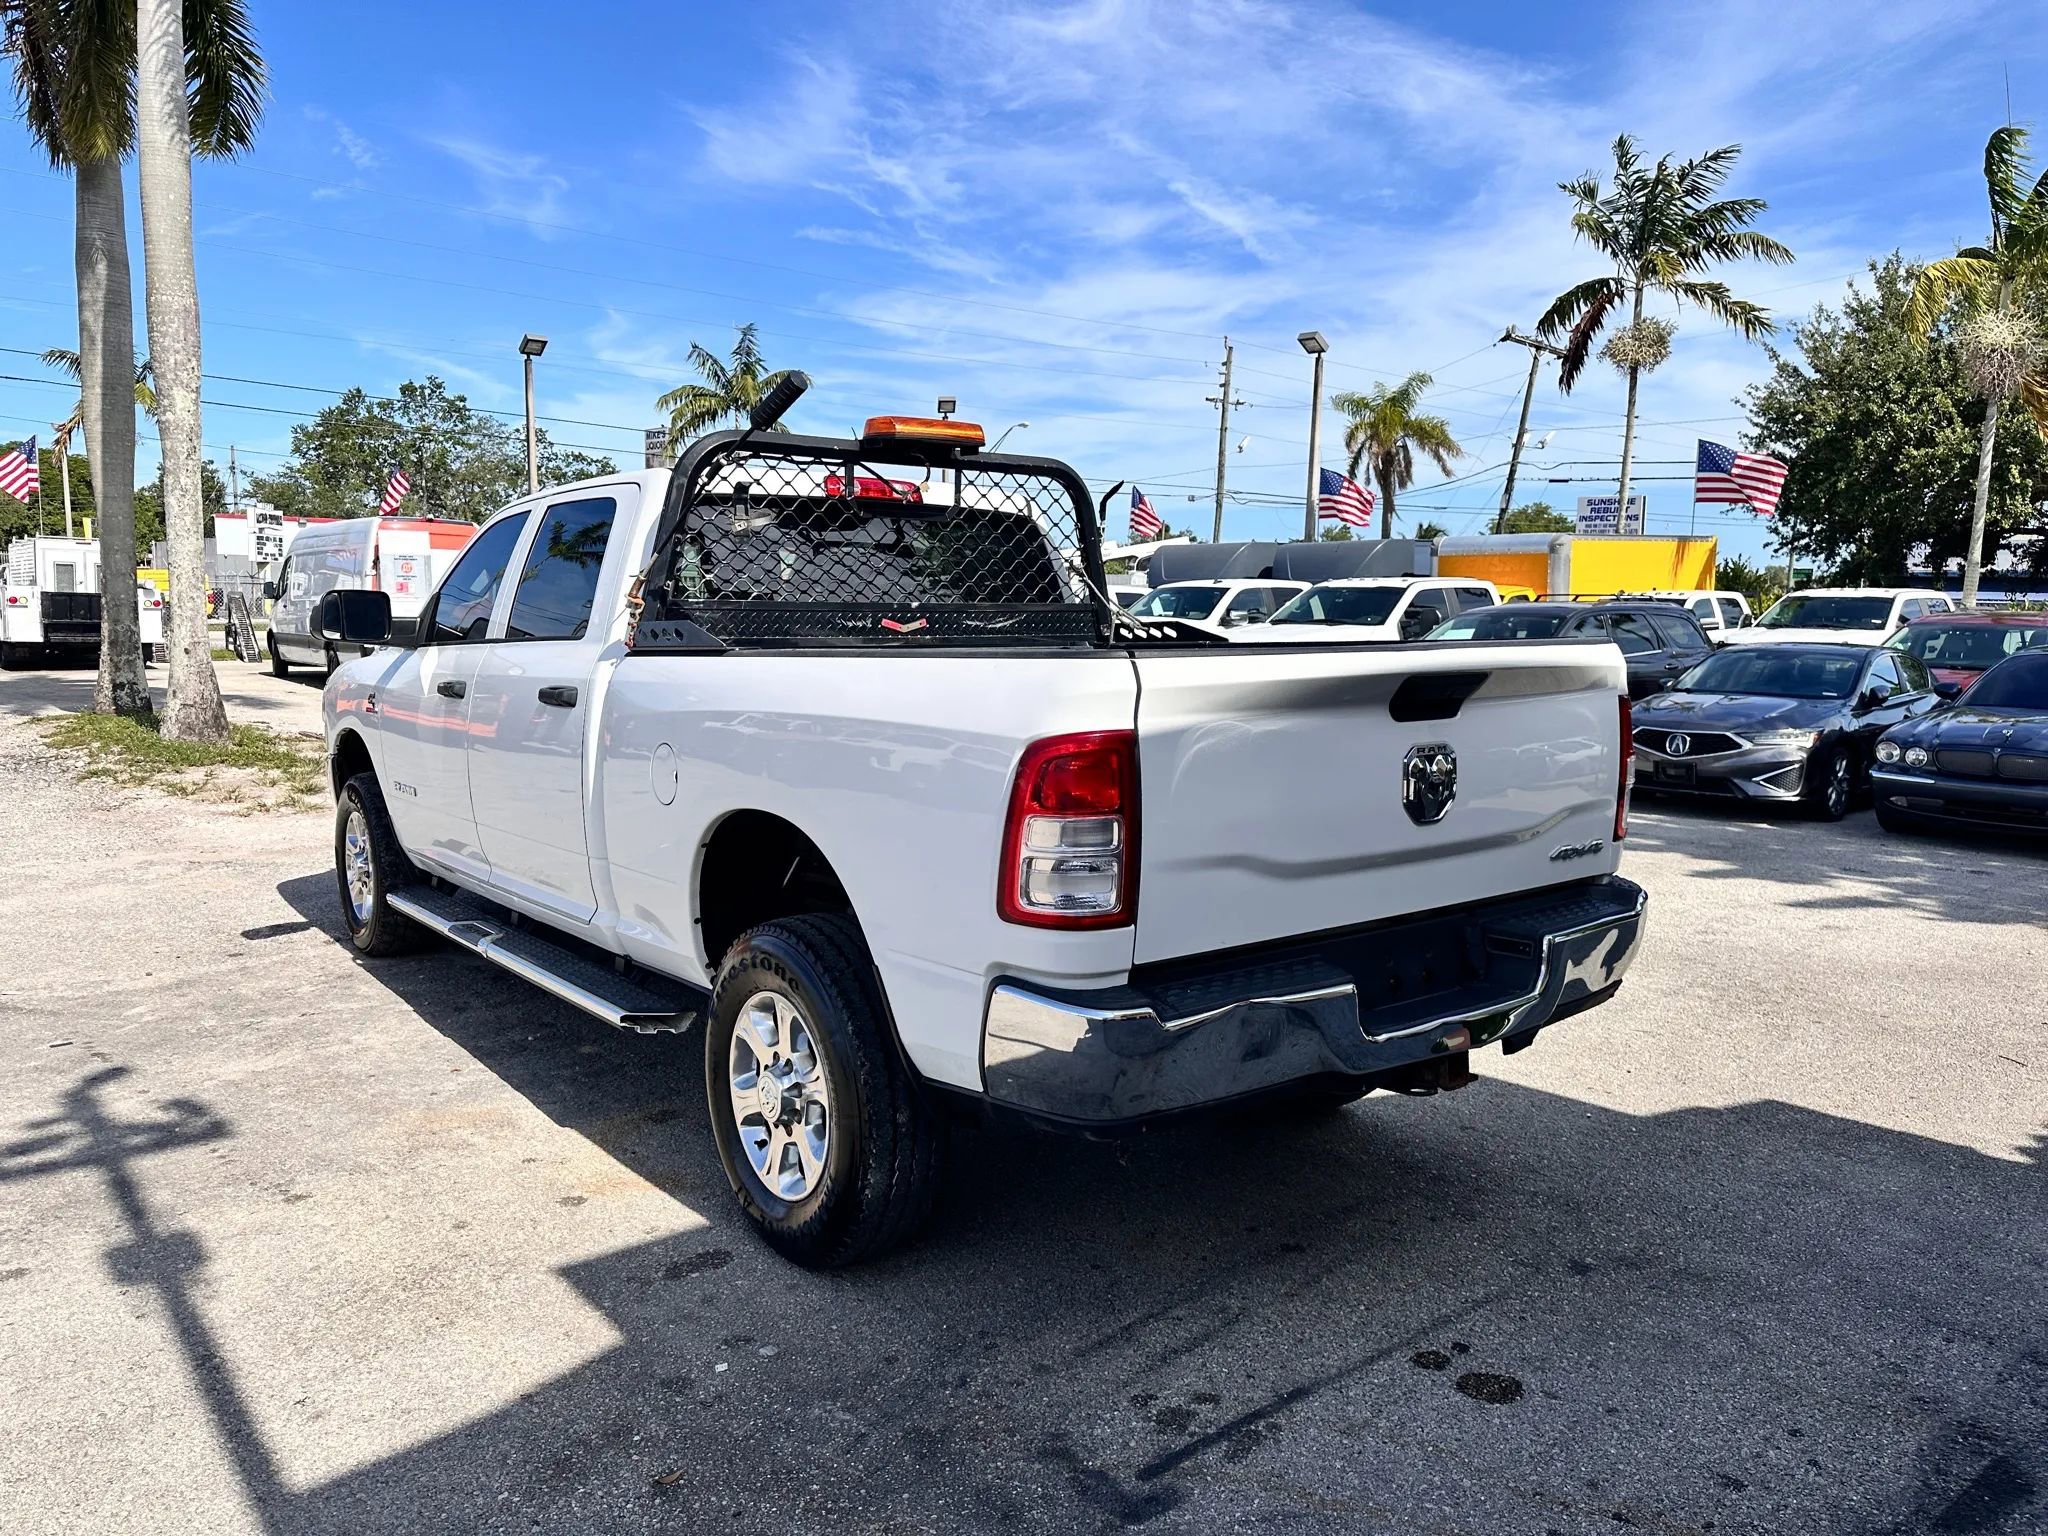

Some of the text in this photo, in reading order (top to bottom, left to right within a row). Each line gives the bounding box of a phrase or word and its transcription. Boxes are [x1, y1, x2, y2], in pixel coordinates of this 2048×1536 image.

[1586, 497, 1637, 507] SUNSHE
[1590, 506, 1630, 515] REBUIT
[1578, 514, 1640, 522] INSPECTNS
[1416, 745, 1448, 755] RAM
